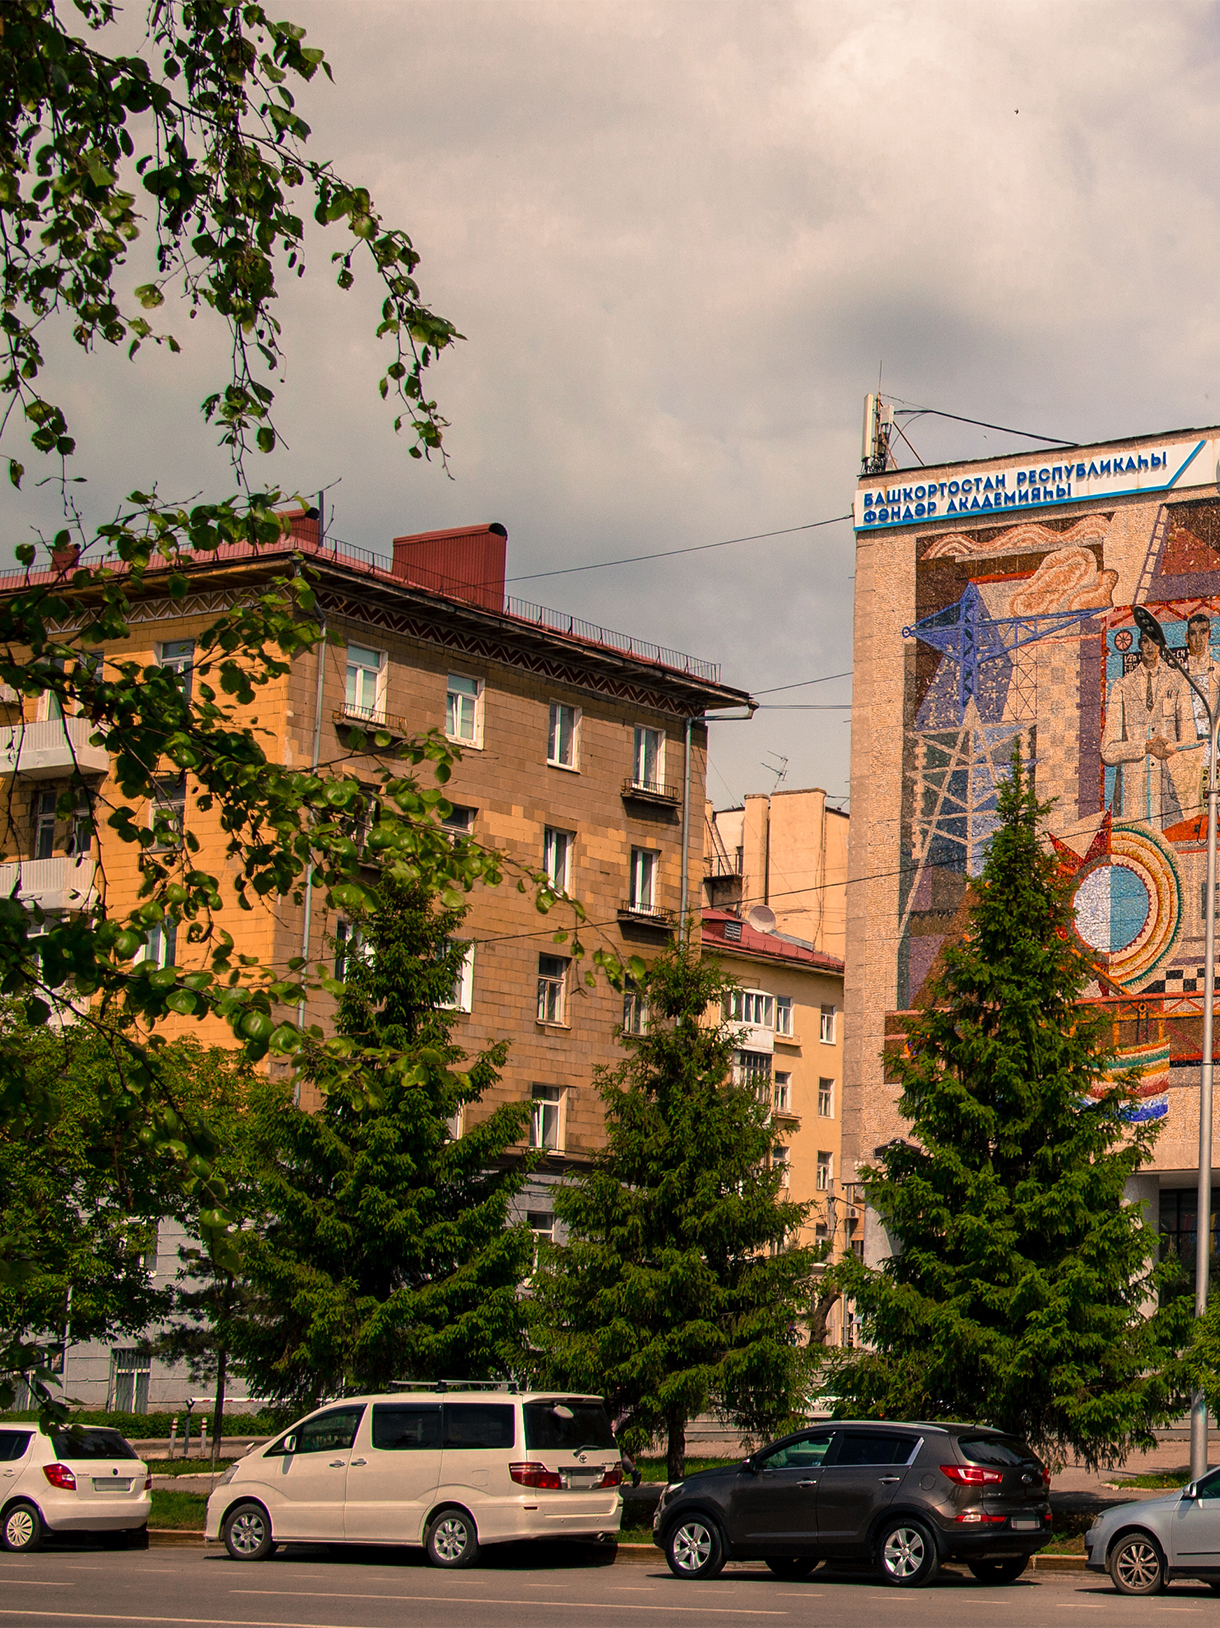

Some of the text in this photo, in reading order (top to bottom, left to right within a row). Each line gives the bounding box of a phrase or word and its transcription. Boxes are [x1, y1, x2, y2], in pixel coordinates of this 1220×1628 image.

[1017, 451, 1167, 486] РЕСПУБЛИКАҺЫ
[863, 483, 1072, 523] ФӘНДӘР АКАДЕМИЯҺЫ
